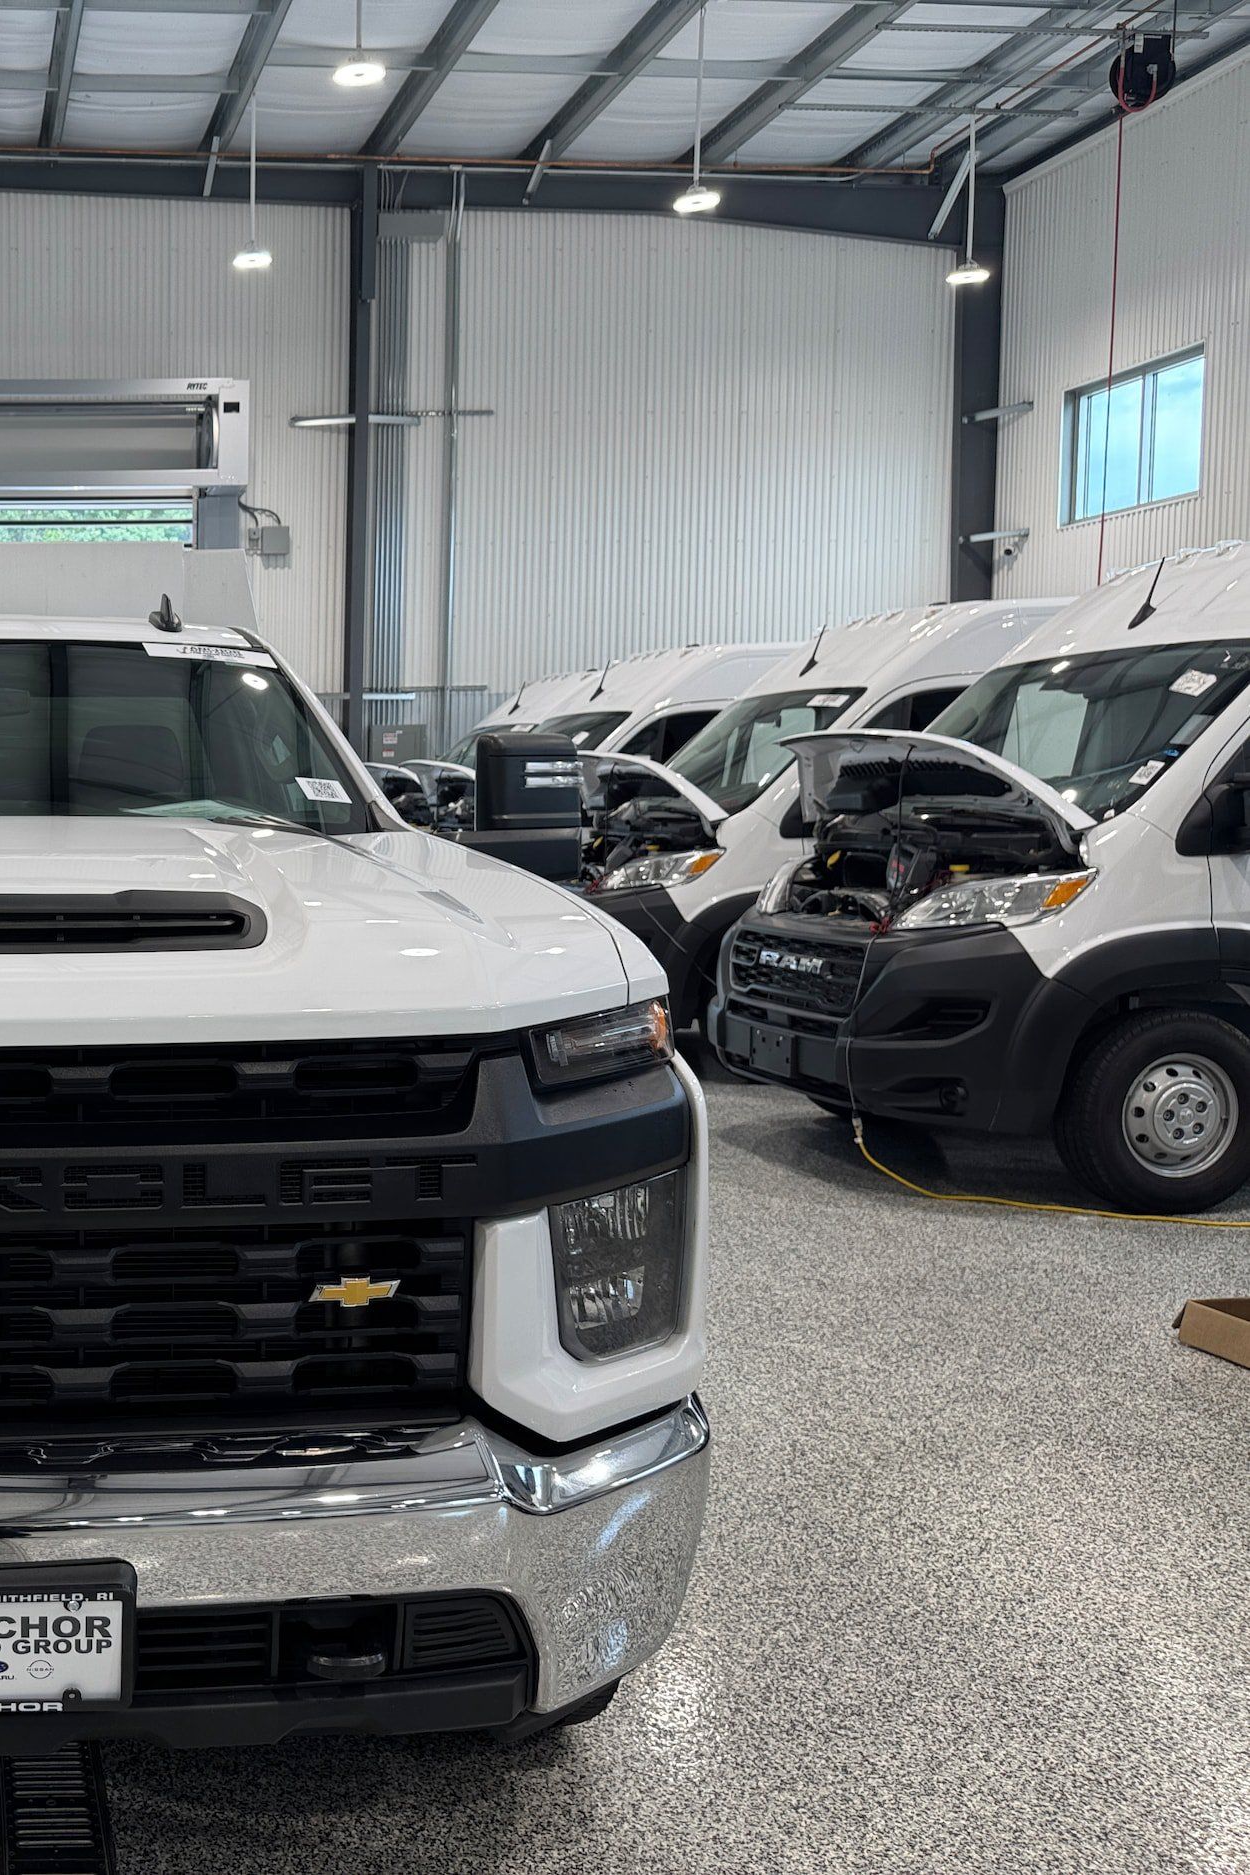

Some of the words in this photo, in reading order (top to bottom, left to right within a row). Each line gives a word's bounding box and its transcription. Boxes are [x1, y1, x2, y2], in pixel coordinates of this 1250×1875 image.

[186, 382, 208, 390] RYTEC
[758, 950, 823, 975] RAM
[96, 1592, 114, 1601] RI
[11, 1639, 112, 1654] GROUP
